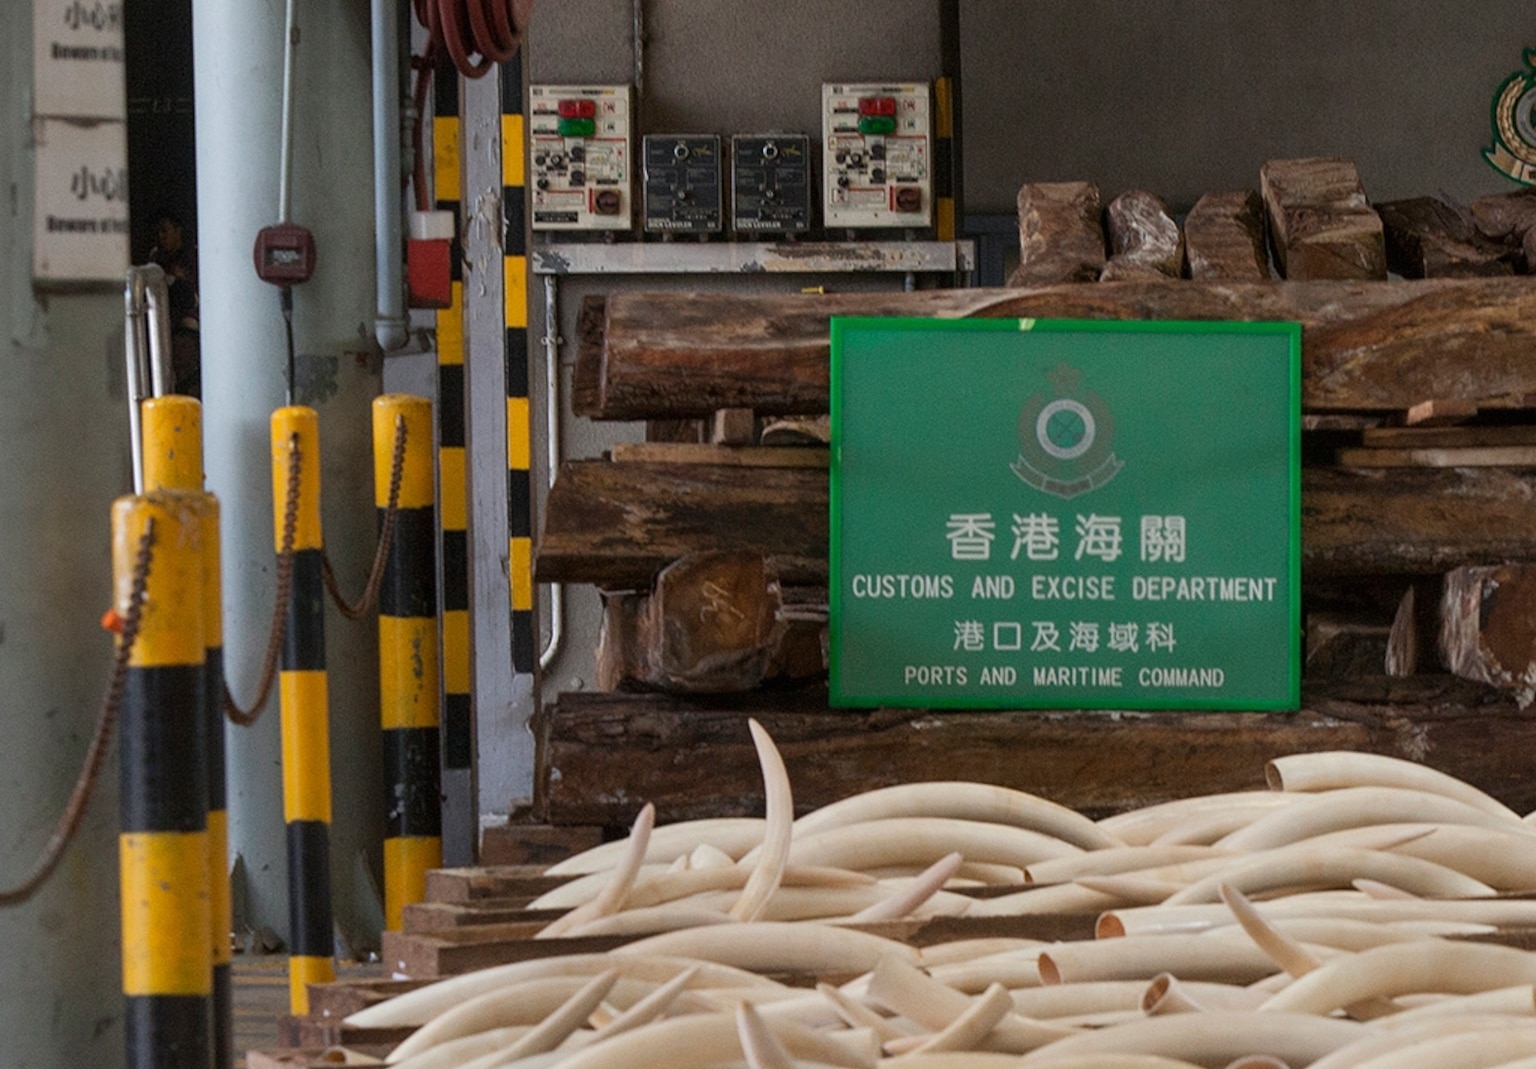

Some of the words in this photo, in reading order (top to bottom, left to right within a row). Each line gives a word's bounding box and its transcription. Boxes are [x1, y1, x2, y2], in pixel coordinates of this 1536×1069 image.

[946, 513, 1186, 562] 香港海關
[852, 574, 954, 599] CUSTOMS
[971, 575, 1015, 599] AND
[1031, 575, 1115, 600] EXCISE
[1132, 577, 1277, 601] DEPARTMENT
[953, 620, 1177, 653] 港口及海域科
[904, 666, 968, 685] PORTS
[980, 667, 1017, 686] AND
[1033, 667, 1123, 687] MARITIME
[1138, 668, 1225, 687] COMMAND
